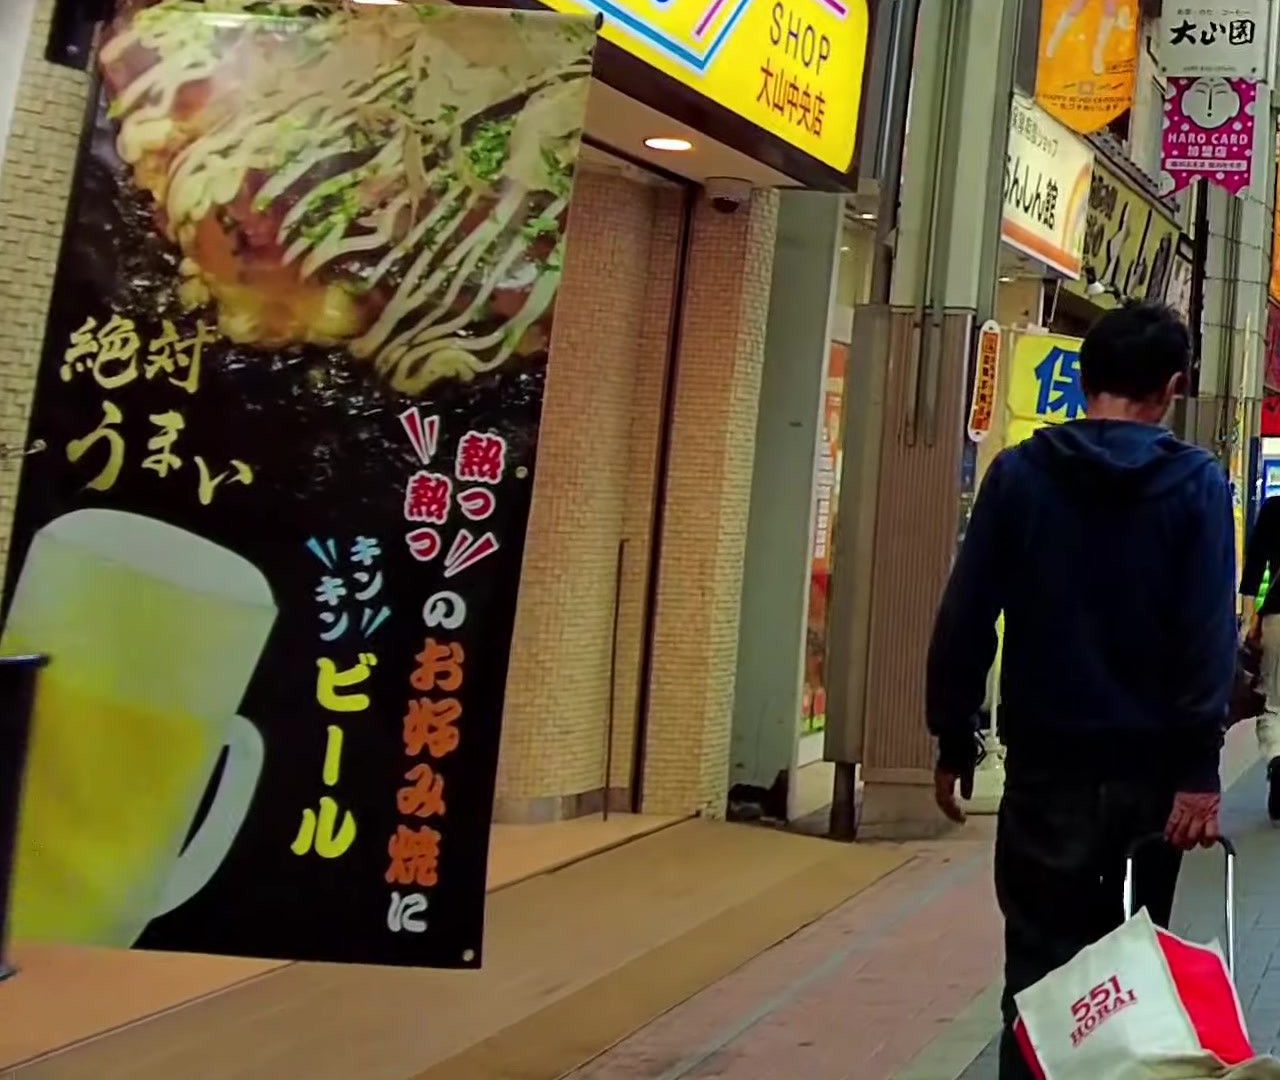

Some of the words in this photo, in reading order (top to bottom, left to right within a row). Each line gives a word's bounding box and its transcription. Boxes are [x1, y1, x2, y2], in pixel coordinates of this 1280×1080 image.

[769, 6, 833, 72] SHOP
[755, 62, 828, 141] 大山中央店
[1167, 132, 1207, 145] HARO
[1211, 132, 1249, 145] CARD
[59, 315, 219, 394] 絶対
[64, 399, 254, 507] うまい
[348, 533, 385, 602] キン
[315, 575, 351, 643] キン
[290, 652, 378, 860] ビール
[1069, 988, 1139, 1049] HORAI
[1070, 974, 1124, 1024] 551
